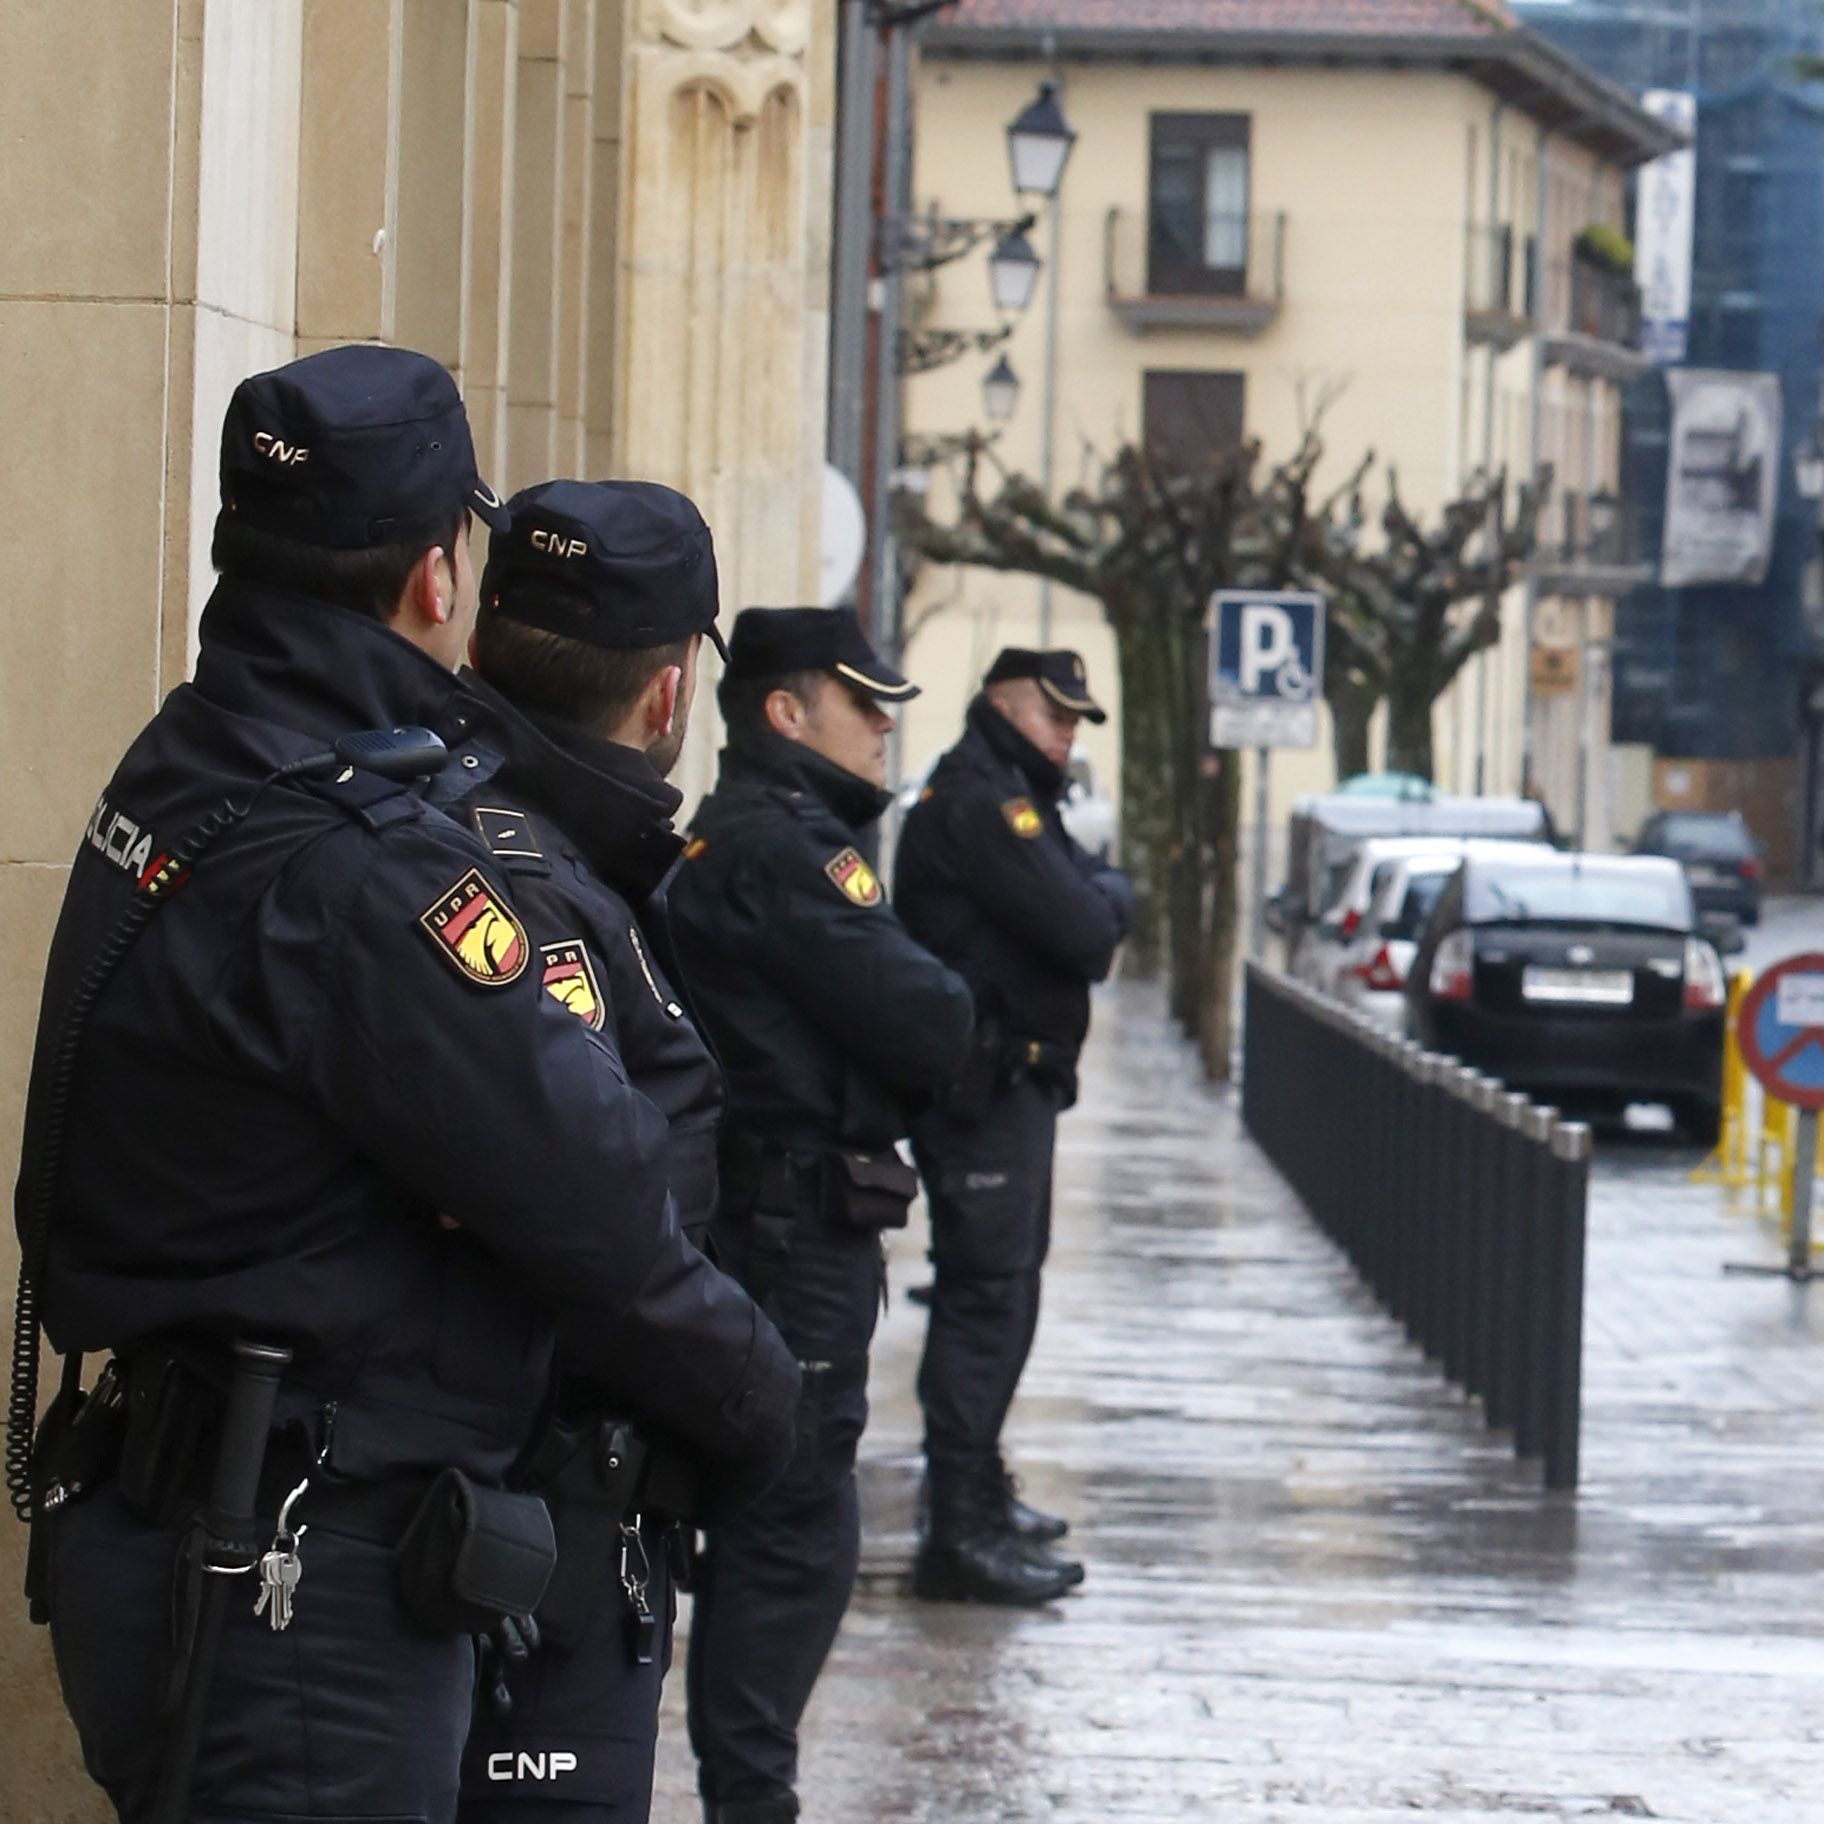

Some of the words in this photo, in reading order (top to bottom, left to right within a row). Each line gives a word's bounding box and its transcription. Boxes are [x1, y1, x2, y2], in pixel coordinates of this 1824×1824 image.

[253, 431, 310, 466] CNP
[531, 529, 587, 558] CNP
[1240, 605, 1294, 693] P
[87, 797, 153, 878] LICIA
[433, 882, 481, 928] UPR
[545, 950, 578, 966] PR
[487, 1751, 578, 1781] CNP
